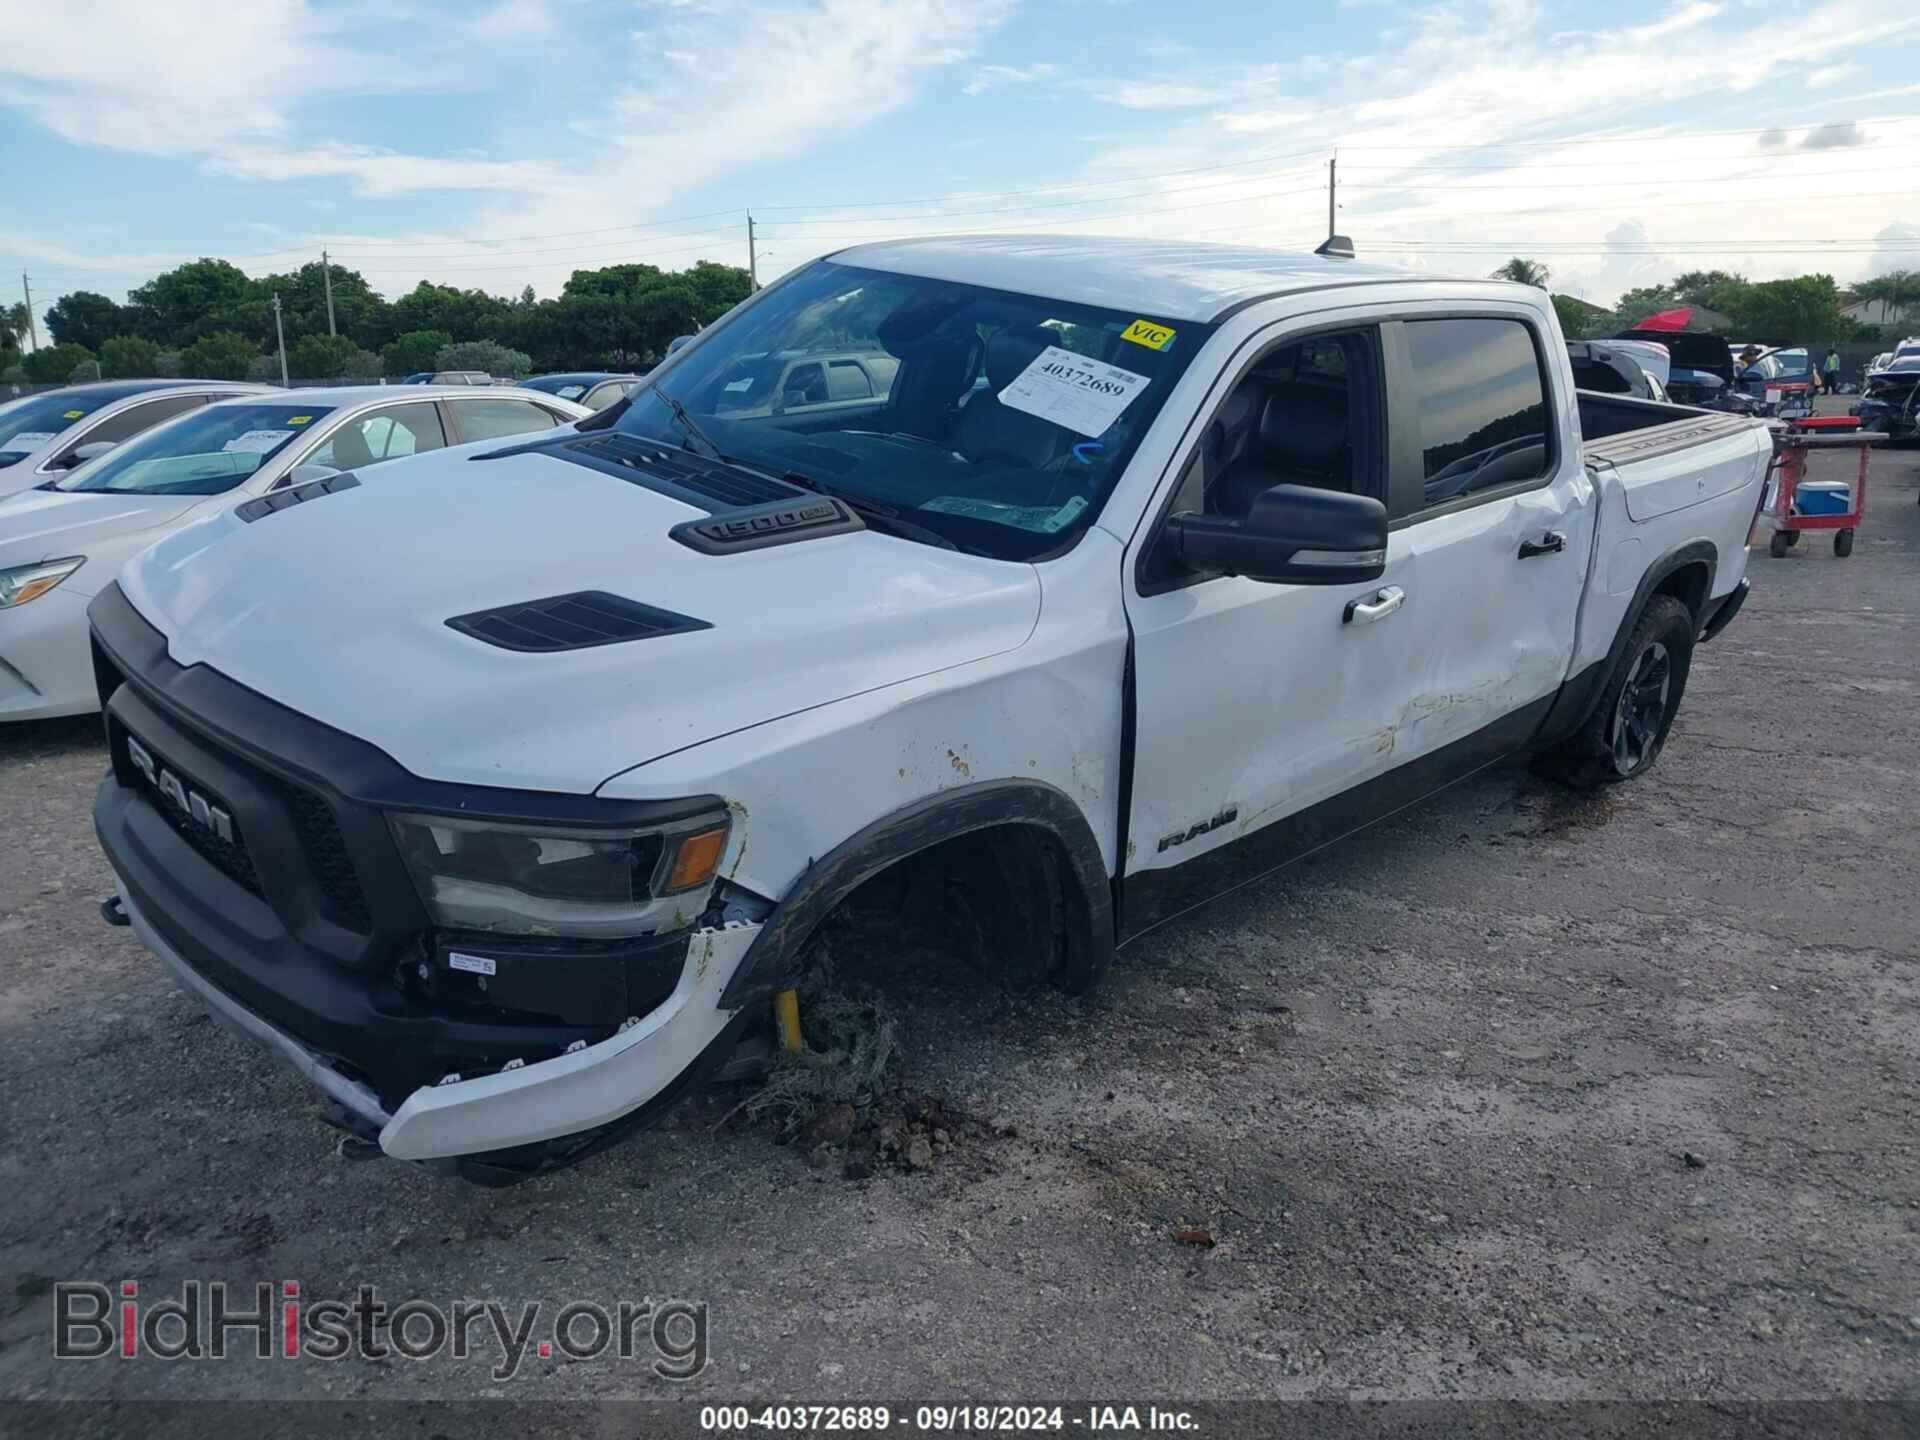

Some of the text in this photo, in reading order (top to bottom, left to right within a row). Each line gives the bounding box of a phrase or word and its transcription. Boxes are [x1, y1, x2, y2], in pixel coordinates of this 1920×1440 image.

[1132, 324, 1167, 343] VIC
[1041, 362, 1126, 397] 40372689
[711, 511, 799, 537] 1500
[127, 735, 234, 843] RAM
[1157, 807, 1238, 853] RAM
